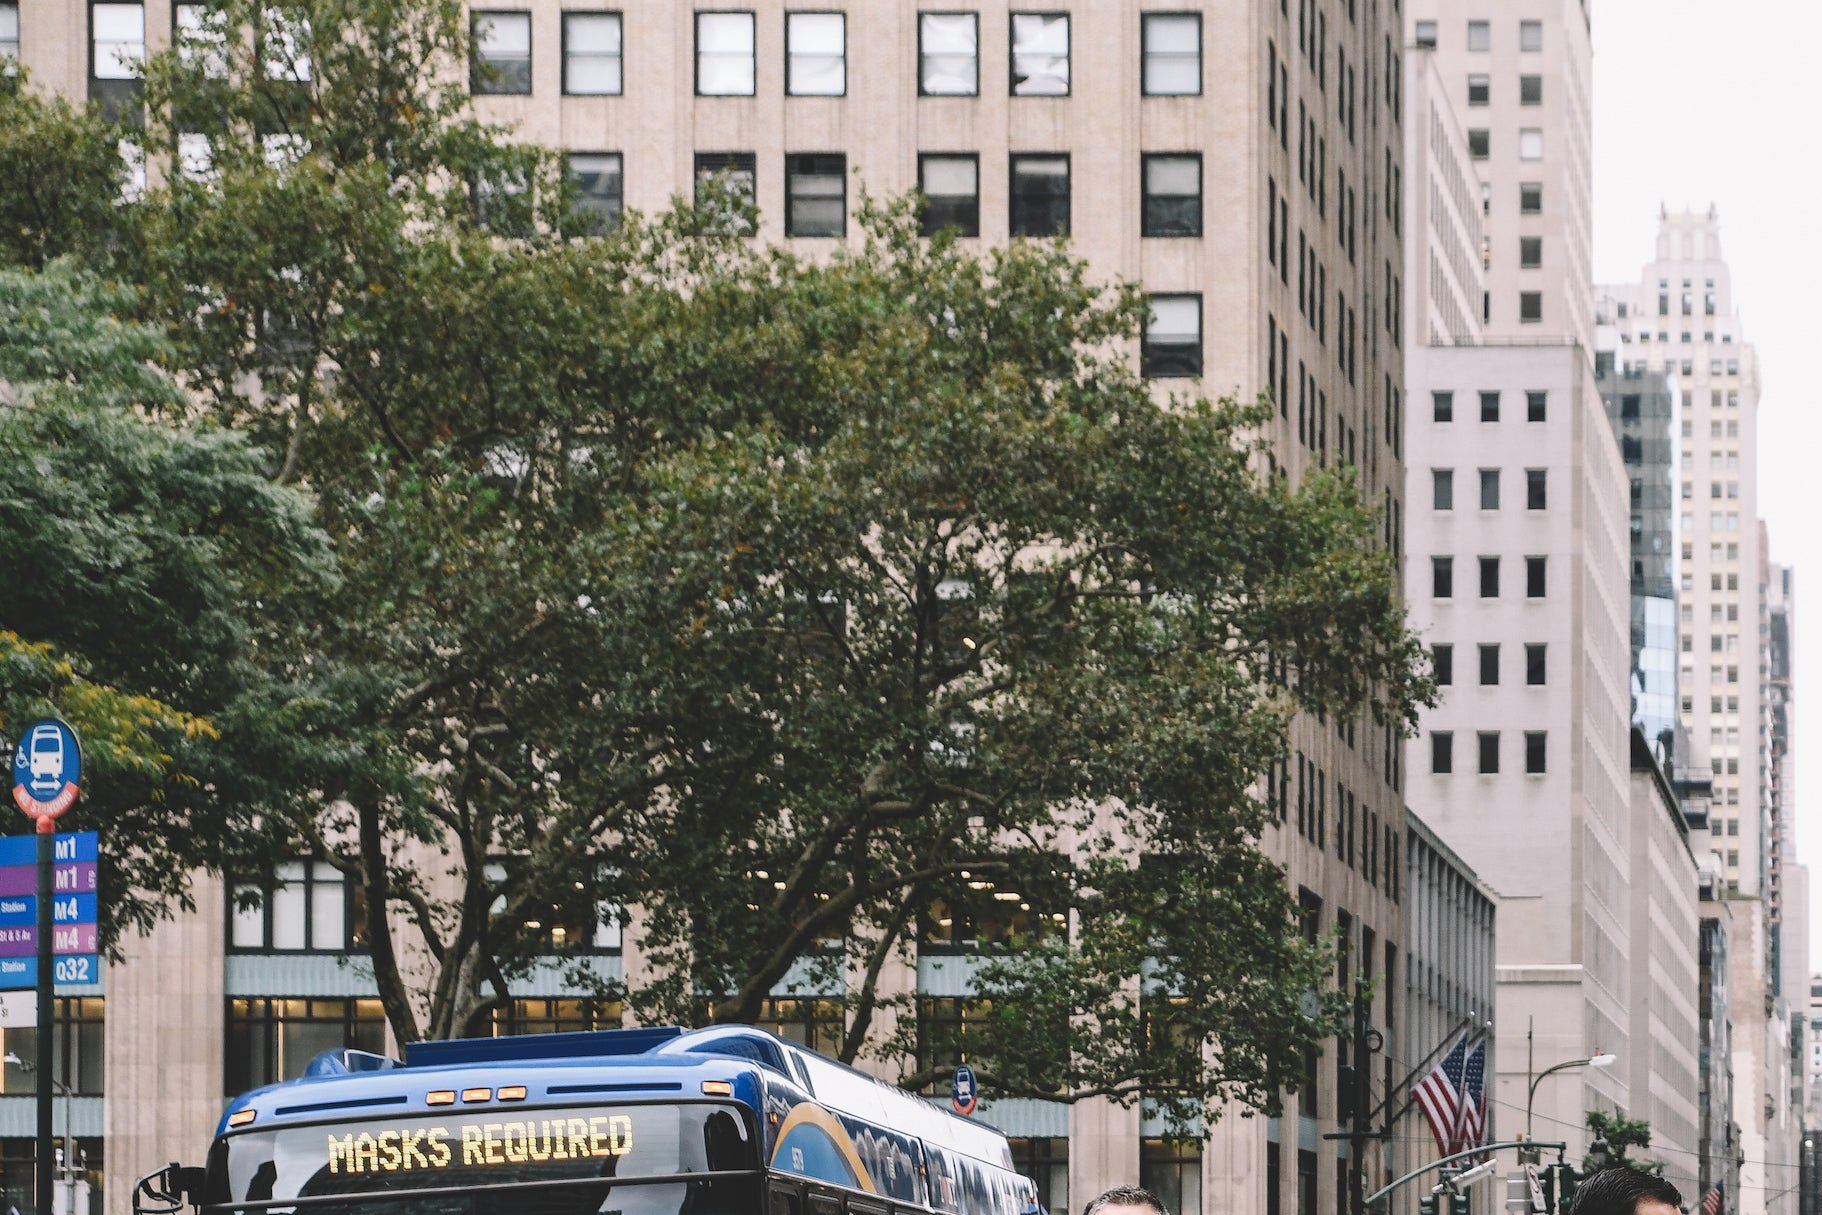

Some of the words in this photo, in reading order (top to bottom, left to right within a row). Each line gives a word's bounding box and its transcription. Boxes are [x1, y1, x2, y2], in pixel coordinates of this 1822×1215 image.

[31, 790, 73, 814] STANDING
[55, 836, 76, 859] M1
[56, 866, 77, 889] M1
[0, 901, 26, 913] Station
[55, 897, 78, 920] M4
[56, 927, 79, 950] M4
[2, 961, 26, 973] Station
[56, 958, 89, 981] Q32
[328, 1127, 452, 1174] MASKS
[462, 1115, 633, 1165] REQUIRED
